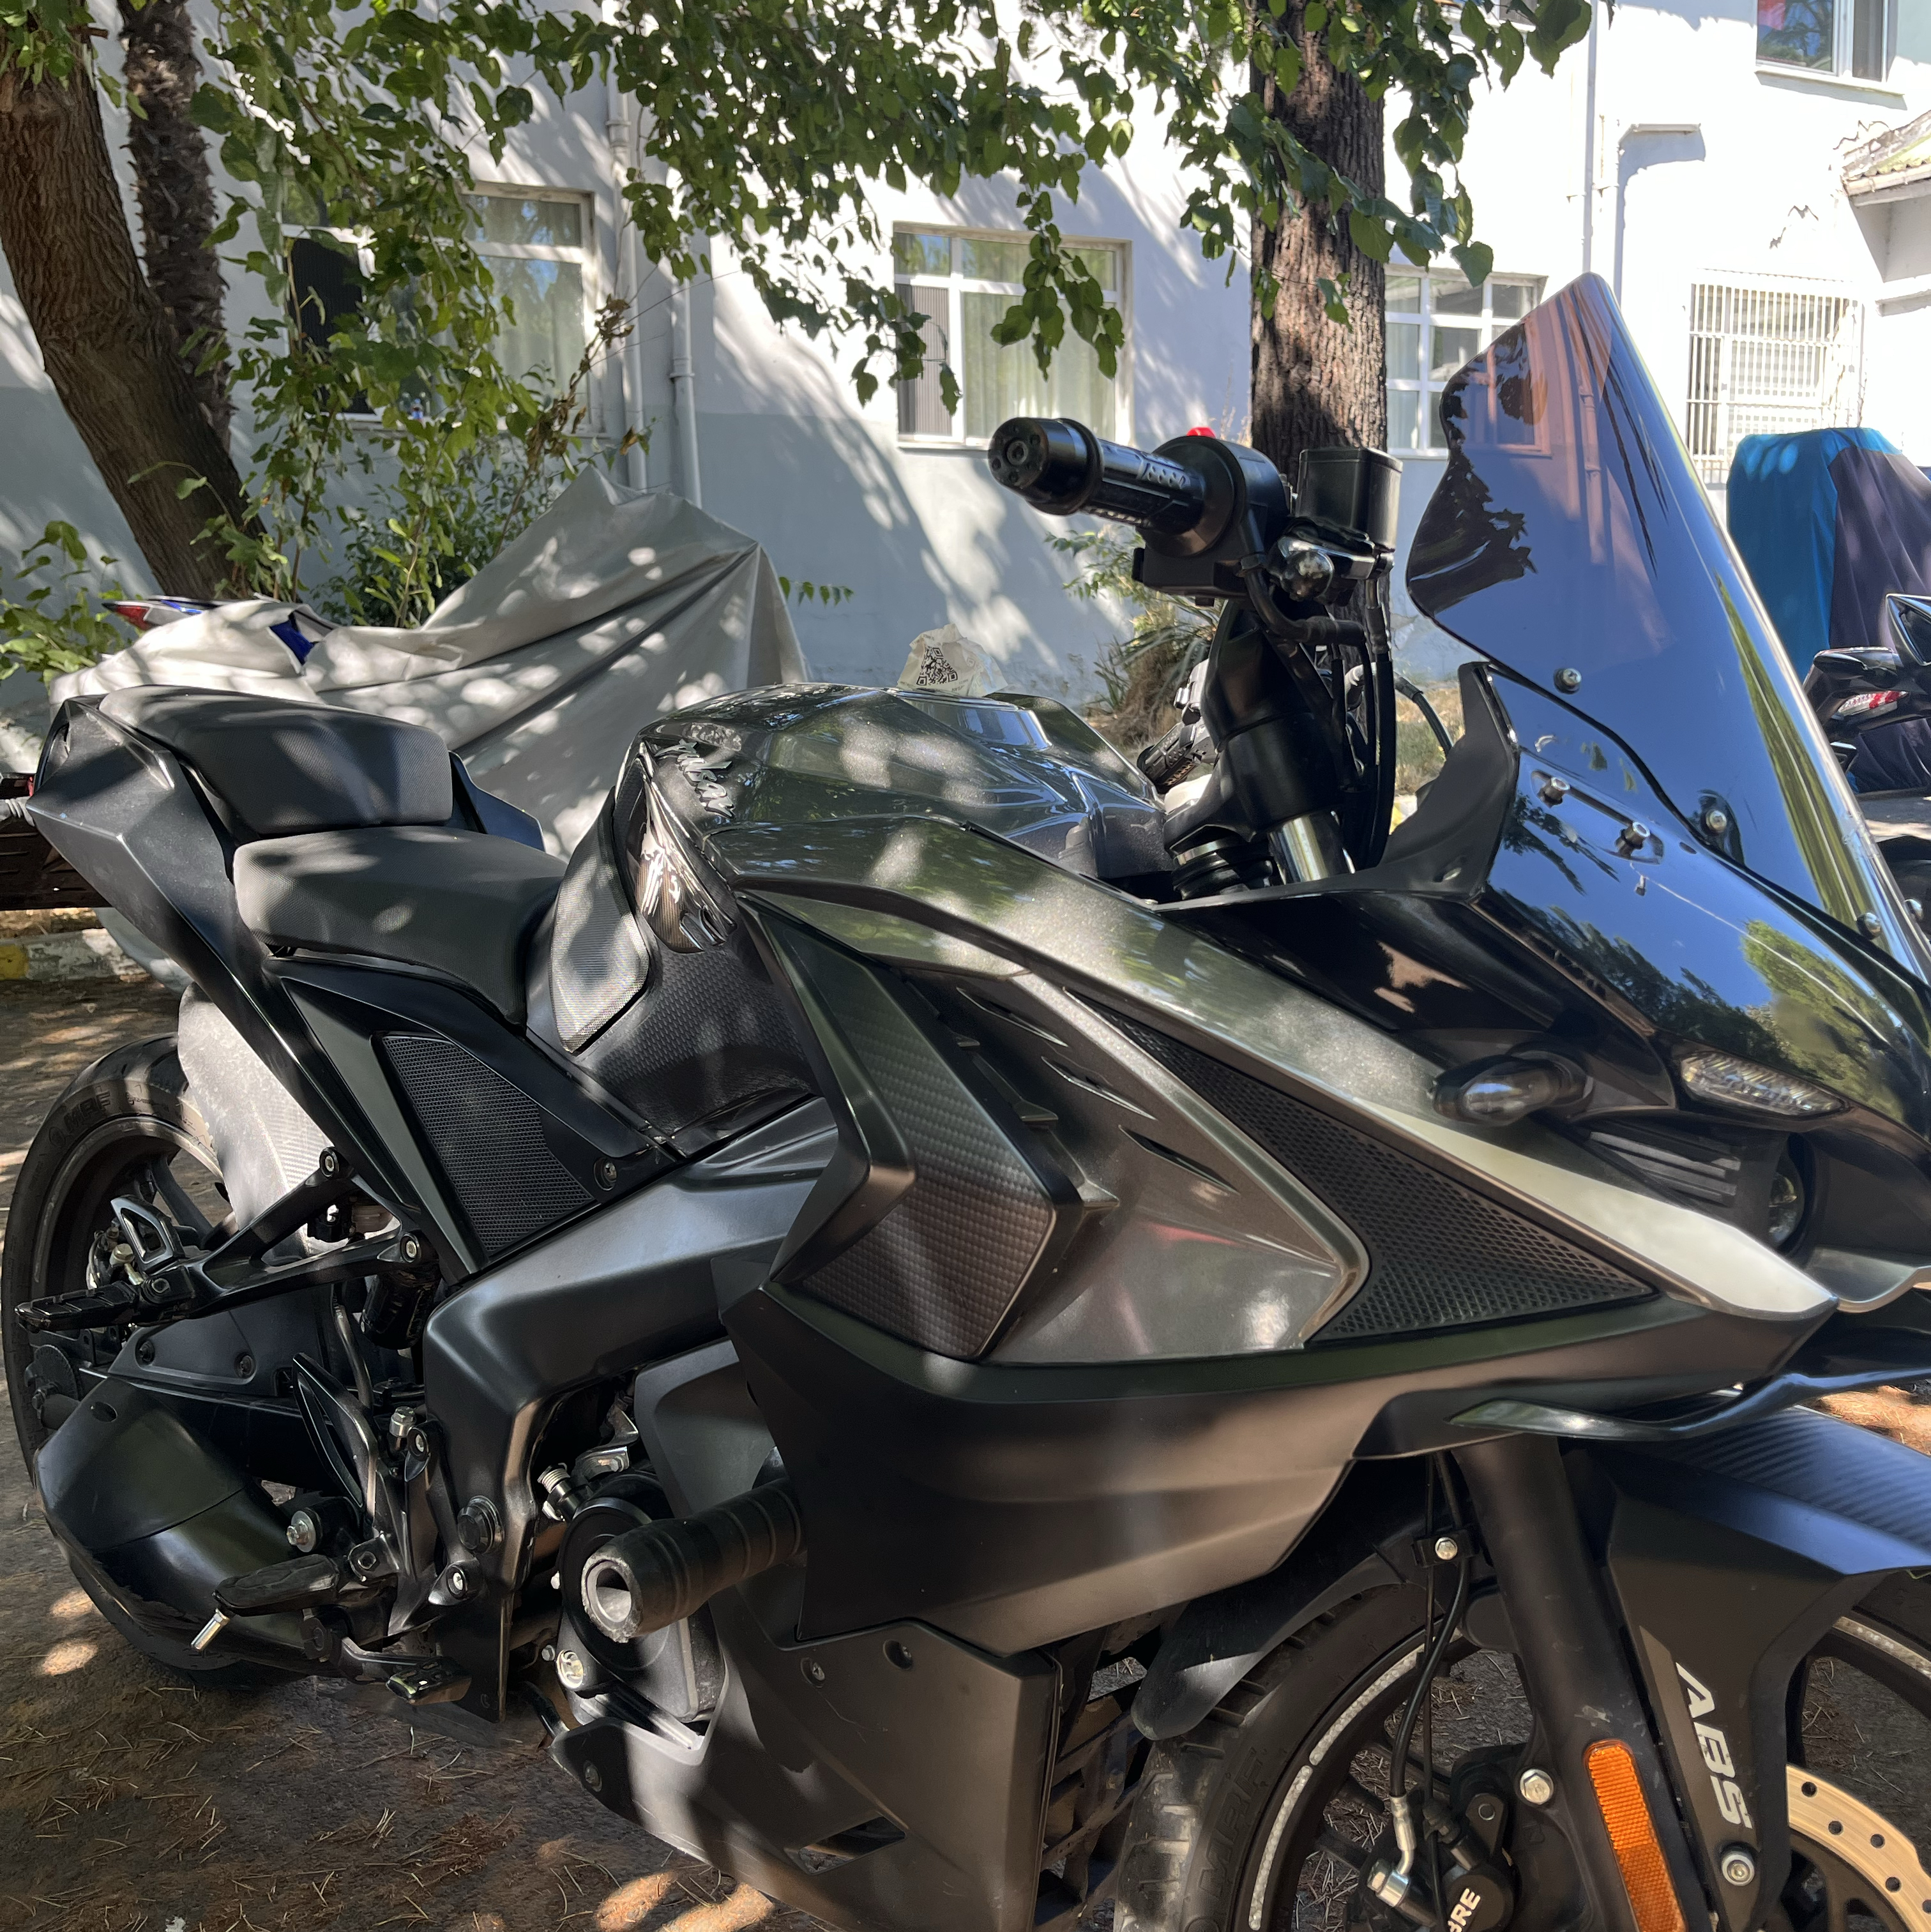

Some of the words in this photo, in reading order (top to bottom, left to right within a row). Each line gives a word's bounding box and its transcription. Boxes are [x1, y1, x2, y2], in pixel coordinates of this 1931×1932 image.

[63, 1085, 111, 1131] MRF
[1675, 1662, 1753, 1829] ABS
[1198, 1746, 1263, 1899] MRF
